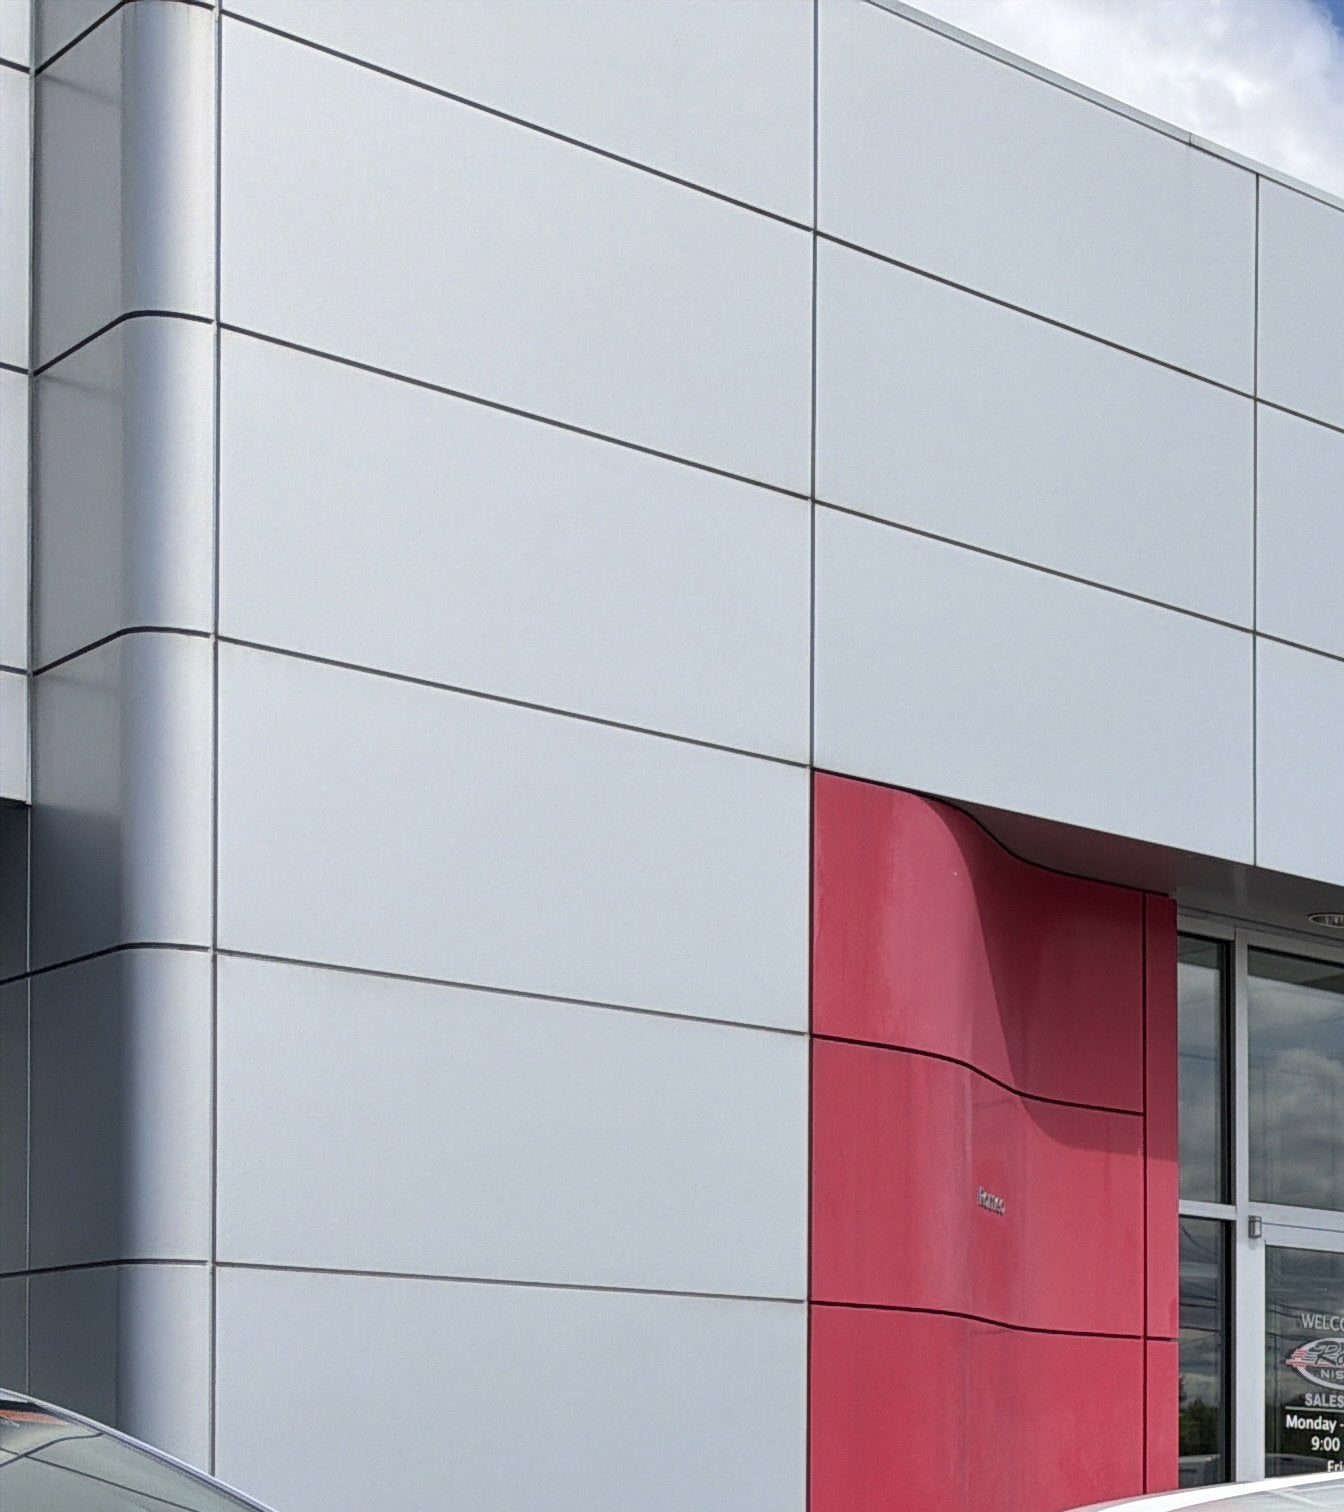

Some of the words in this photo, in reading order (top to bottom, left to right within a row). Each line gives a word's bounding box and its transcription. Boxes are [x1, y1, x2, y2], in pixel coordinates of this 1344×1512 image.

[1304, 1393, 1344, 1409] SALES
[1285, 1414, 1337, 1434] Monday
[1311, 1436, 1340, 1451] 9:00
